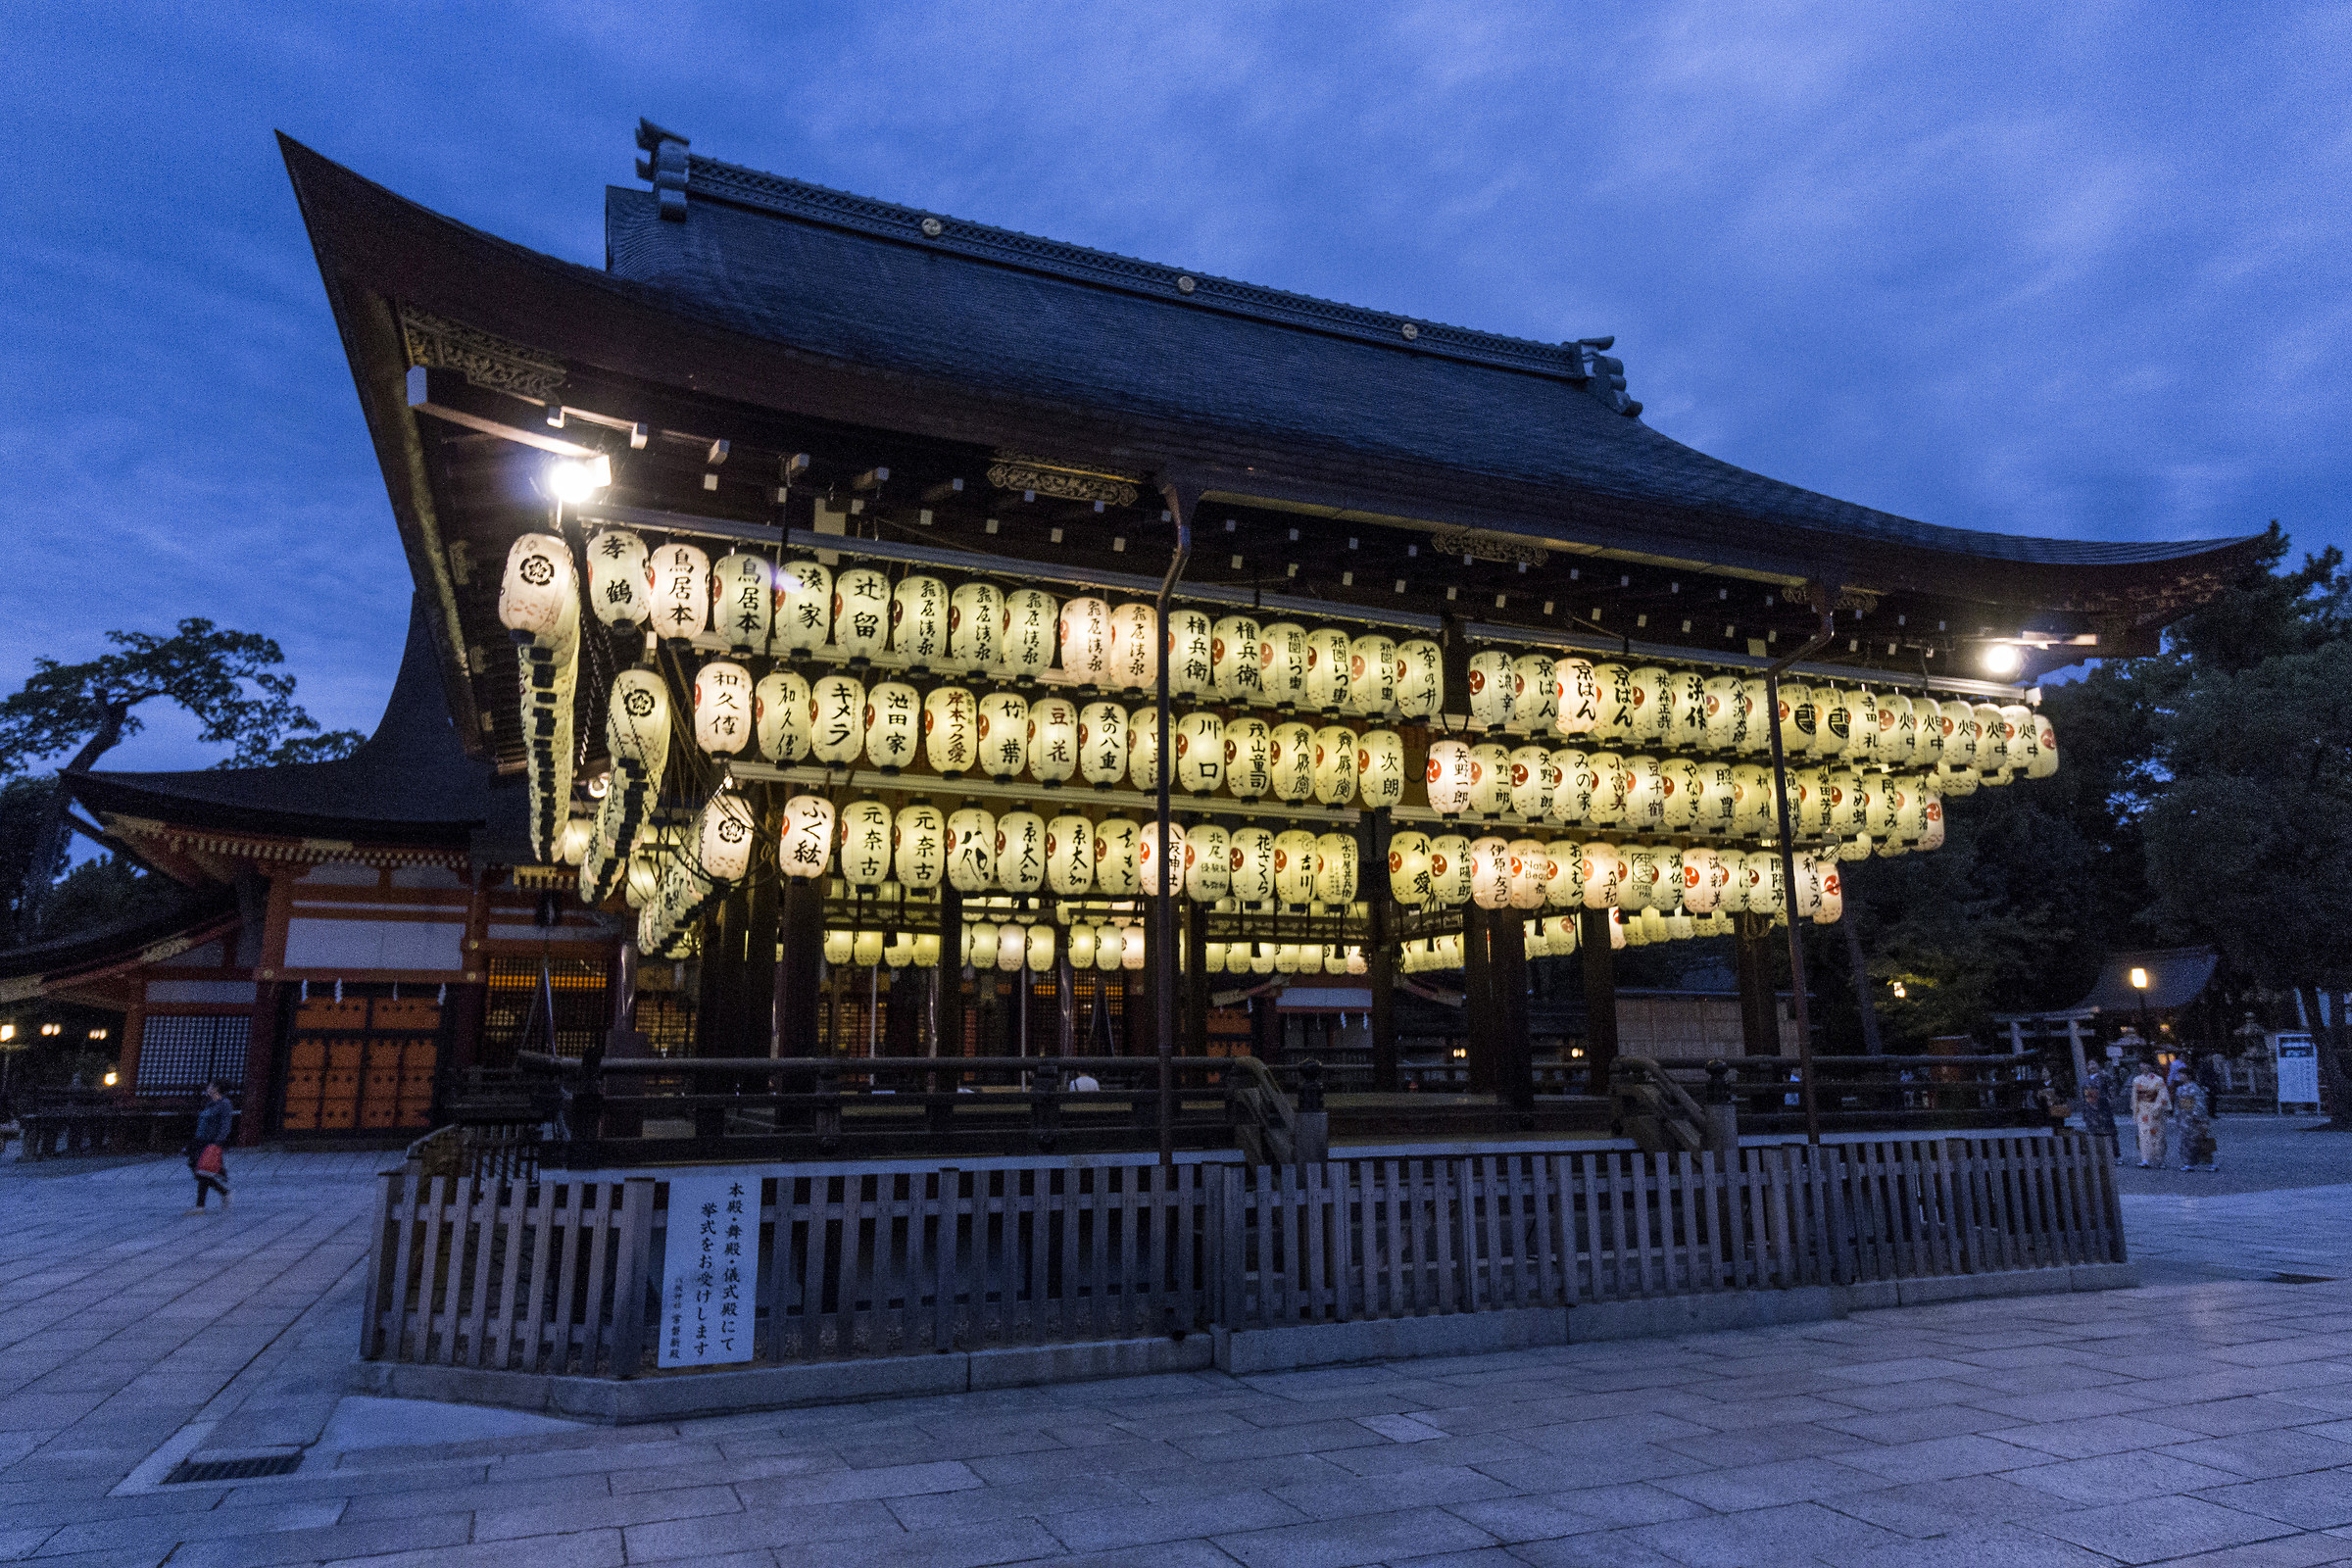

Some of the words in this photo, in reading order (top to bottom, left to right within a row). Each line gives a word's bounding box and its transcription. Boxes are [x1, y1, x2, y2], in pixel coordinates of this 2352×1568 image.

[601, 535, 633, 604] 孝鶴
[669, 547, 695, 625] 鳥居本
[737, 556, 761, 634] 鳥居本
[796, 567, 823, 629] 湊家
[854, 575, 880, 639] 辻留
[1185, 615, 1207, 682] 権兵衛
[1234, 620, 1259, 687] 権兵衛
[825, 682, 854, 747] キメラ
[1534, 659, 1557, 718] 京ばん
[1572, 662, 1596, 721] 京ばん
[1609, 666, 1633, 728] 京ばん
[886, 691, 908, 756] 池田家
[1000, 700, 1021, 764] 竹葉
[1046, 707, 1070, 763] 豆花
[1198, 718, 1219, 779] 川口
[1860, 695, 1879, 749] 寺田礼
[1249, 722, 1268, 791] 茂山童司
[1380, 751, 1399, 797] 次朗
[1453, 747, 1469, 806] 矢野一郎
[1494, 748, 1511, 807] 矢野一郎
[1538, 751, 1554, 809] 矢野一郎
[1574, 753, 1592, 811] みの家
[859, 807, 885, 876] 元奈古
[913, 810, 937, 881] 元奈古
[1208, 832, 1224, 859] 北尾
[1254, 834, 1272, 895] 花さくら
[1300, 854, 1314, 898] 吉川
[693, 1201, 718, 1357] 挙式をお受けします
[719, 1182, 745, 1351] 本殿・舞殿・儀式殿にて
